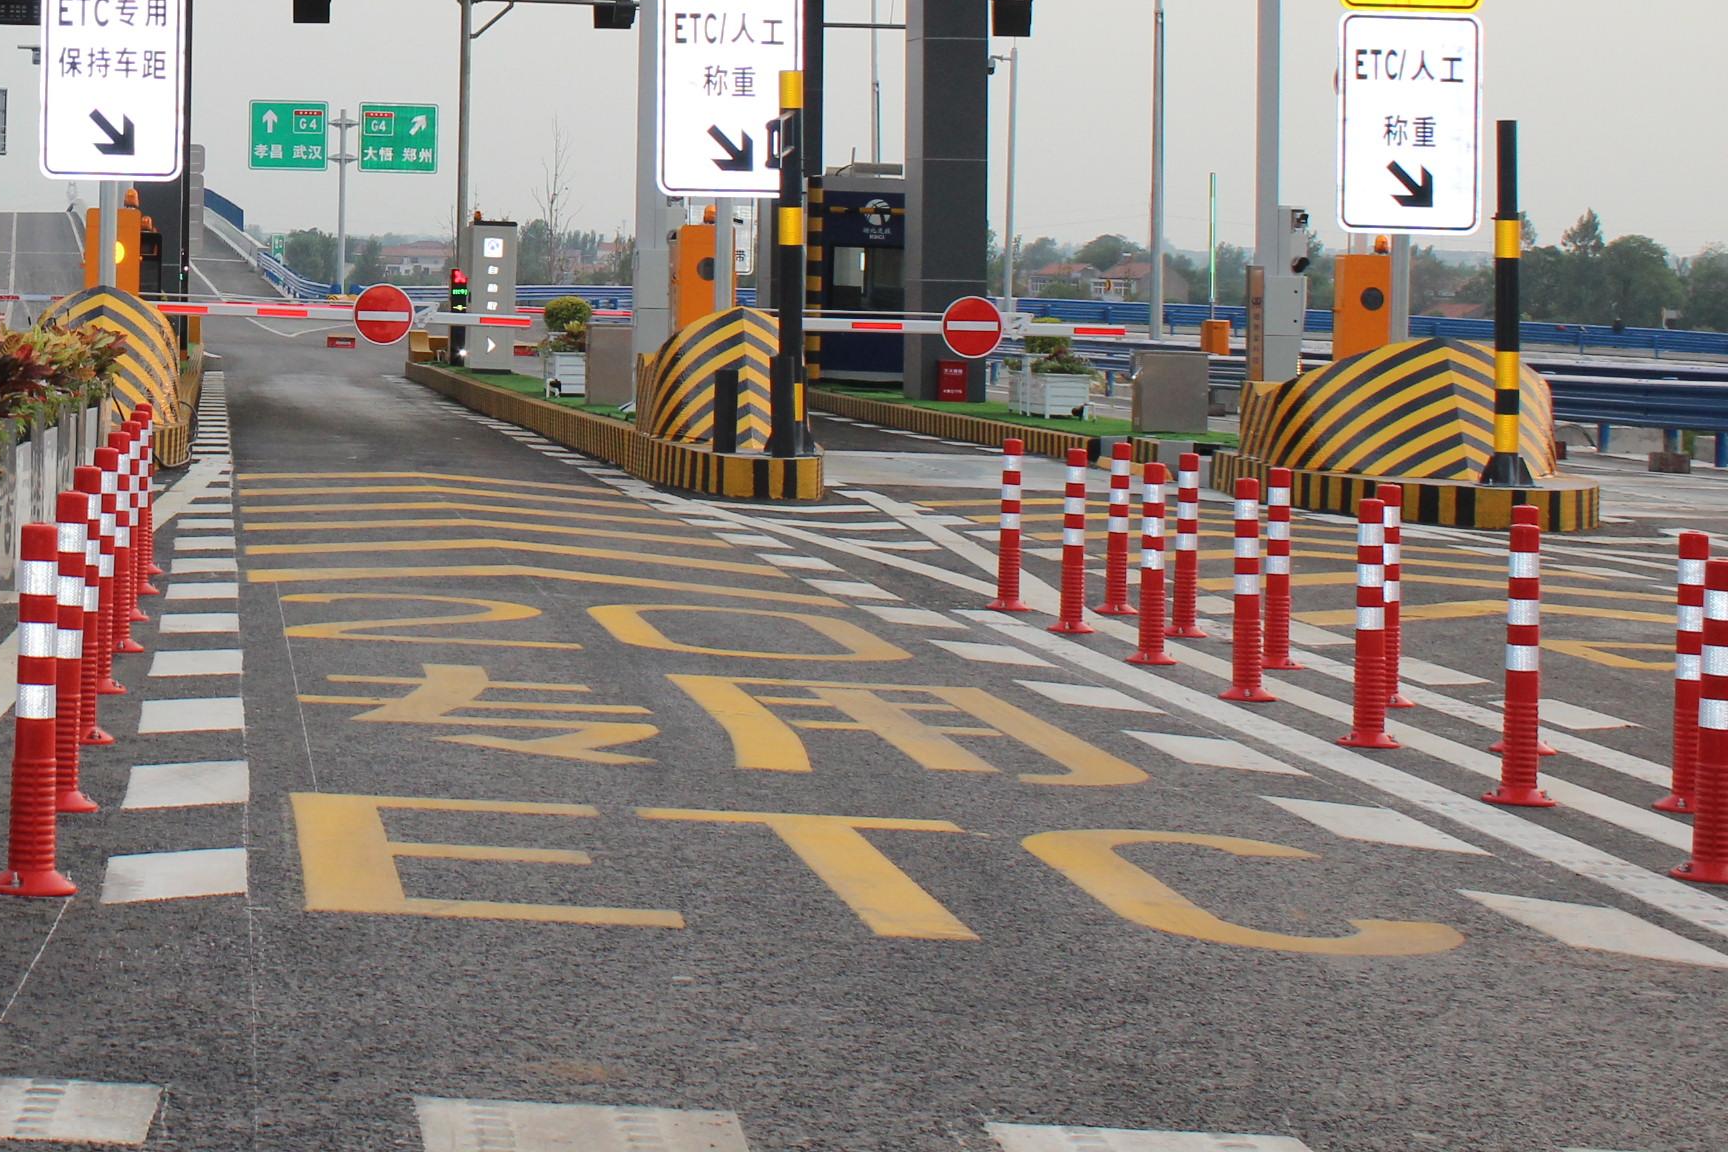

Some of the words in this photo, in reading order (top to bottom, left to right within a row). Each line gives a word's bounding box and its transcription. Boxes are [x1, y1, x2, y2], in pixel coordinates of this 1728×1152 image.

[673, 11, 785, 46] ETC/人工
[57, 46, 168, 80] 保持车距
[1354, 48, 1465, 84] ETC/人工
[703, 64, 757, 97] 称重
[298, 117, 318, 131] G4
[370, 119, 387, 133] G4
[1382, 114, 1437, 148] 称重
[253, 143, 284, 160] 孝昌
[292, 145, 323, 160] 武汉
[362, 146, 394, 162] 大悟
[401, 147, 433, 164] 郑州
[281, 591, 914, 663] 20
[296, 662, 1151, 787] 专用
[289, 790, 1466, 956] ETC
